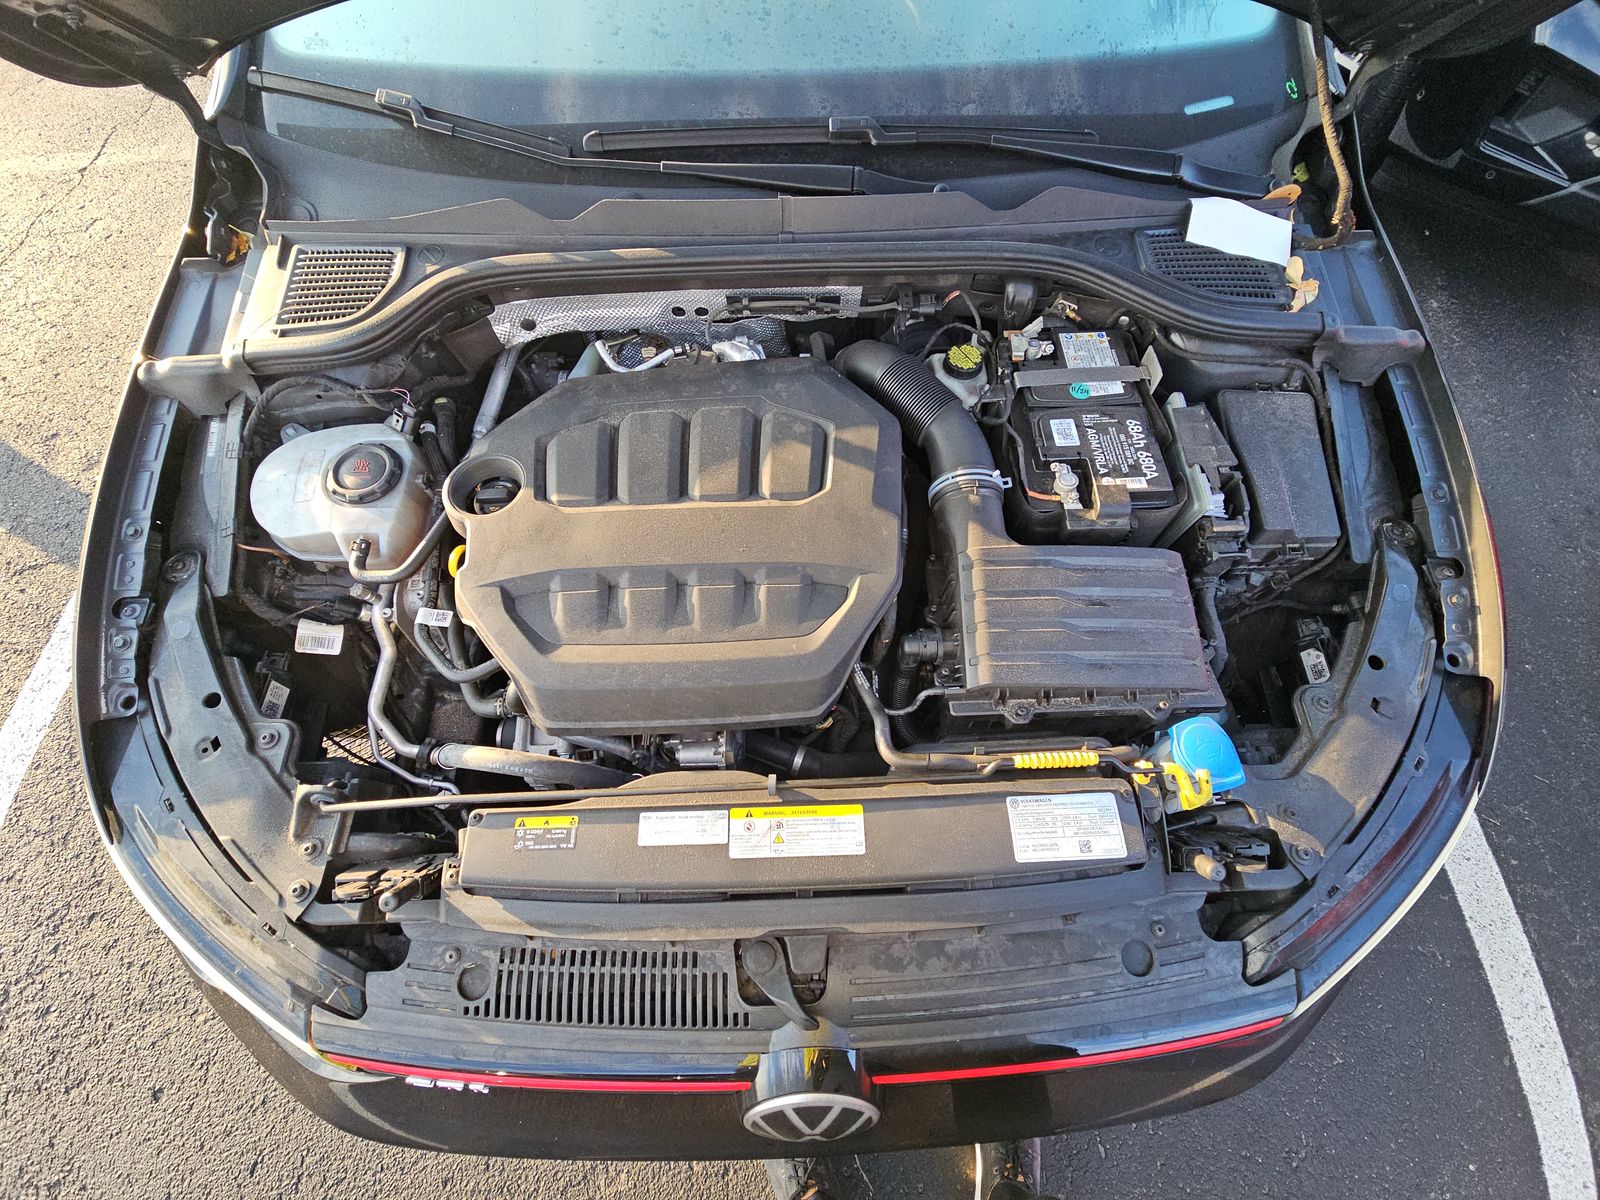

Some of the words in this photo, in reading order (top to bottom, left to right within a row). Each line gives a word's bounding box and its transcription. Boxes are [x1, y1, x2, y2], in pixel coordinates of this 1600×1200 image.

[1126, 419, 1148, 448] 68Ah
[1085, 427, 1109, 475] AGM/VRLA
[1136, 450, 1159, 480] 680A
